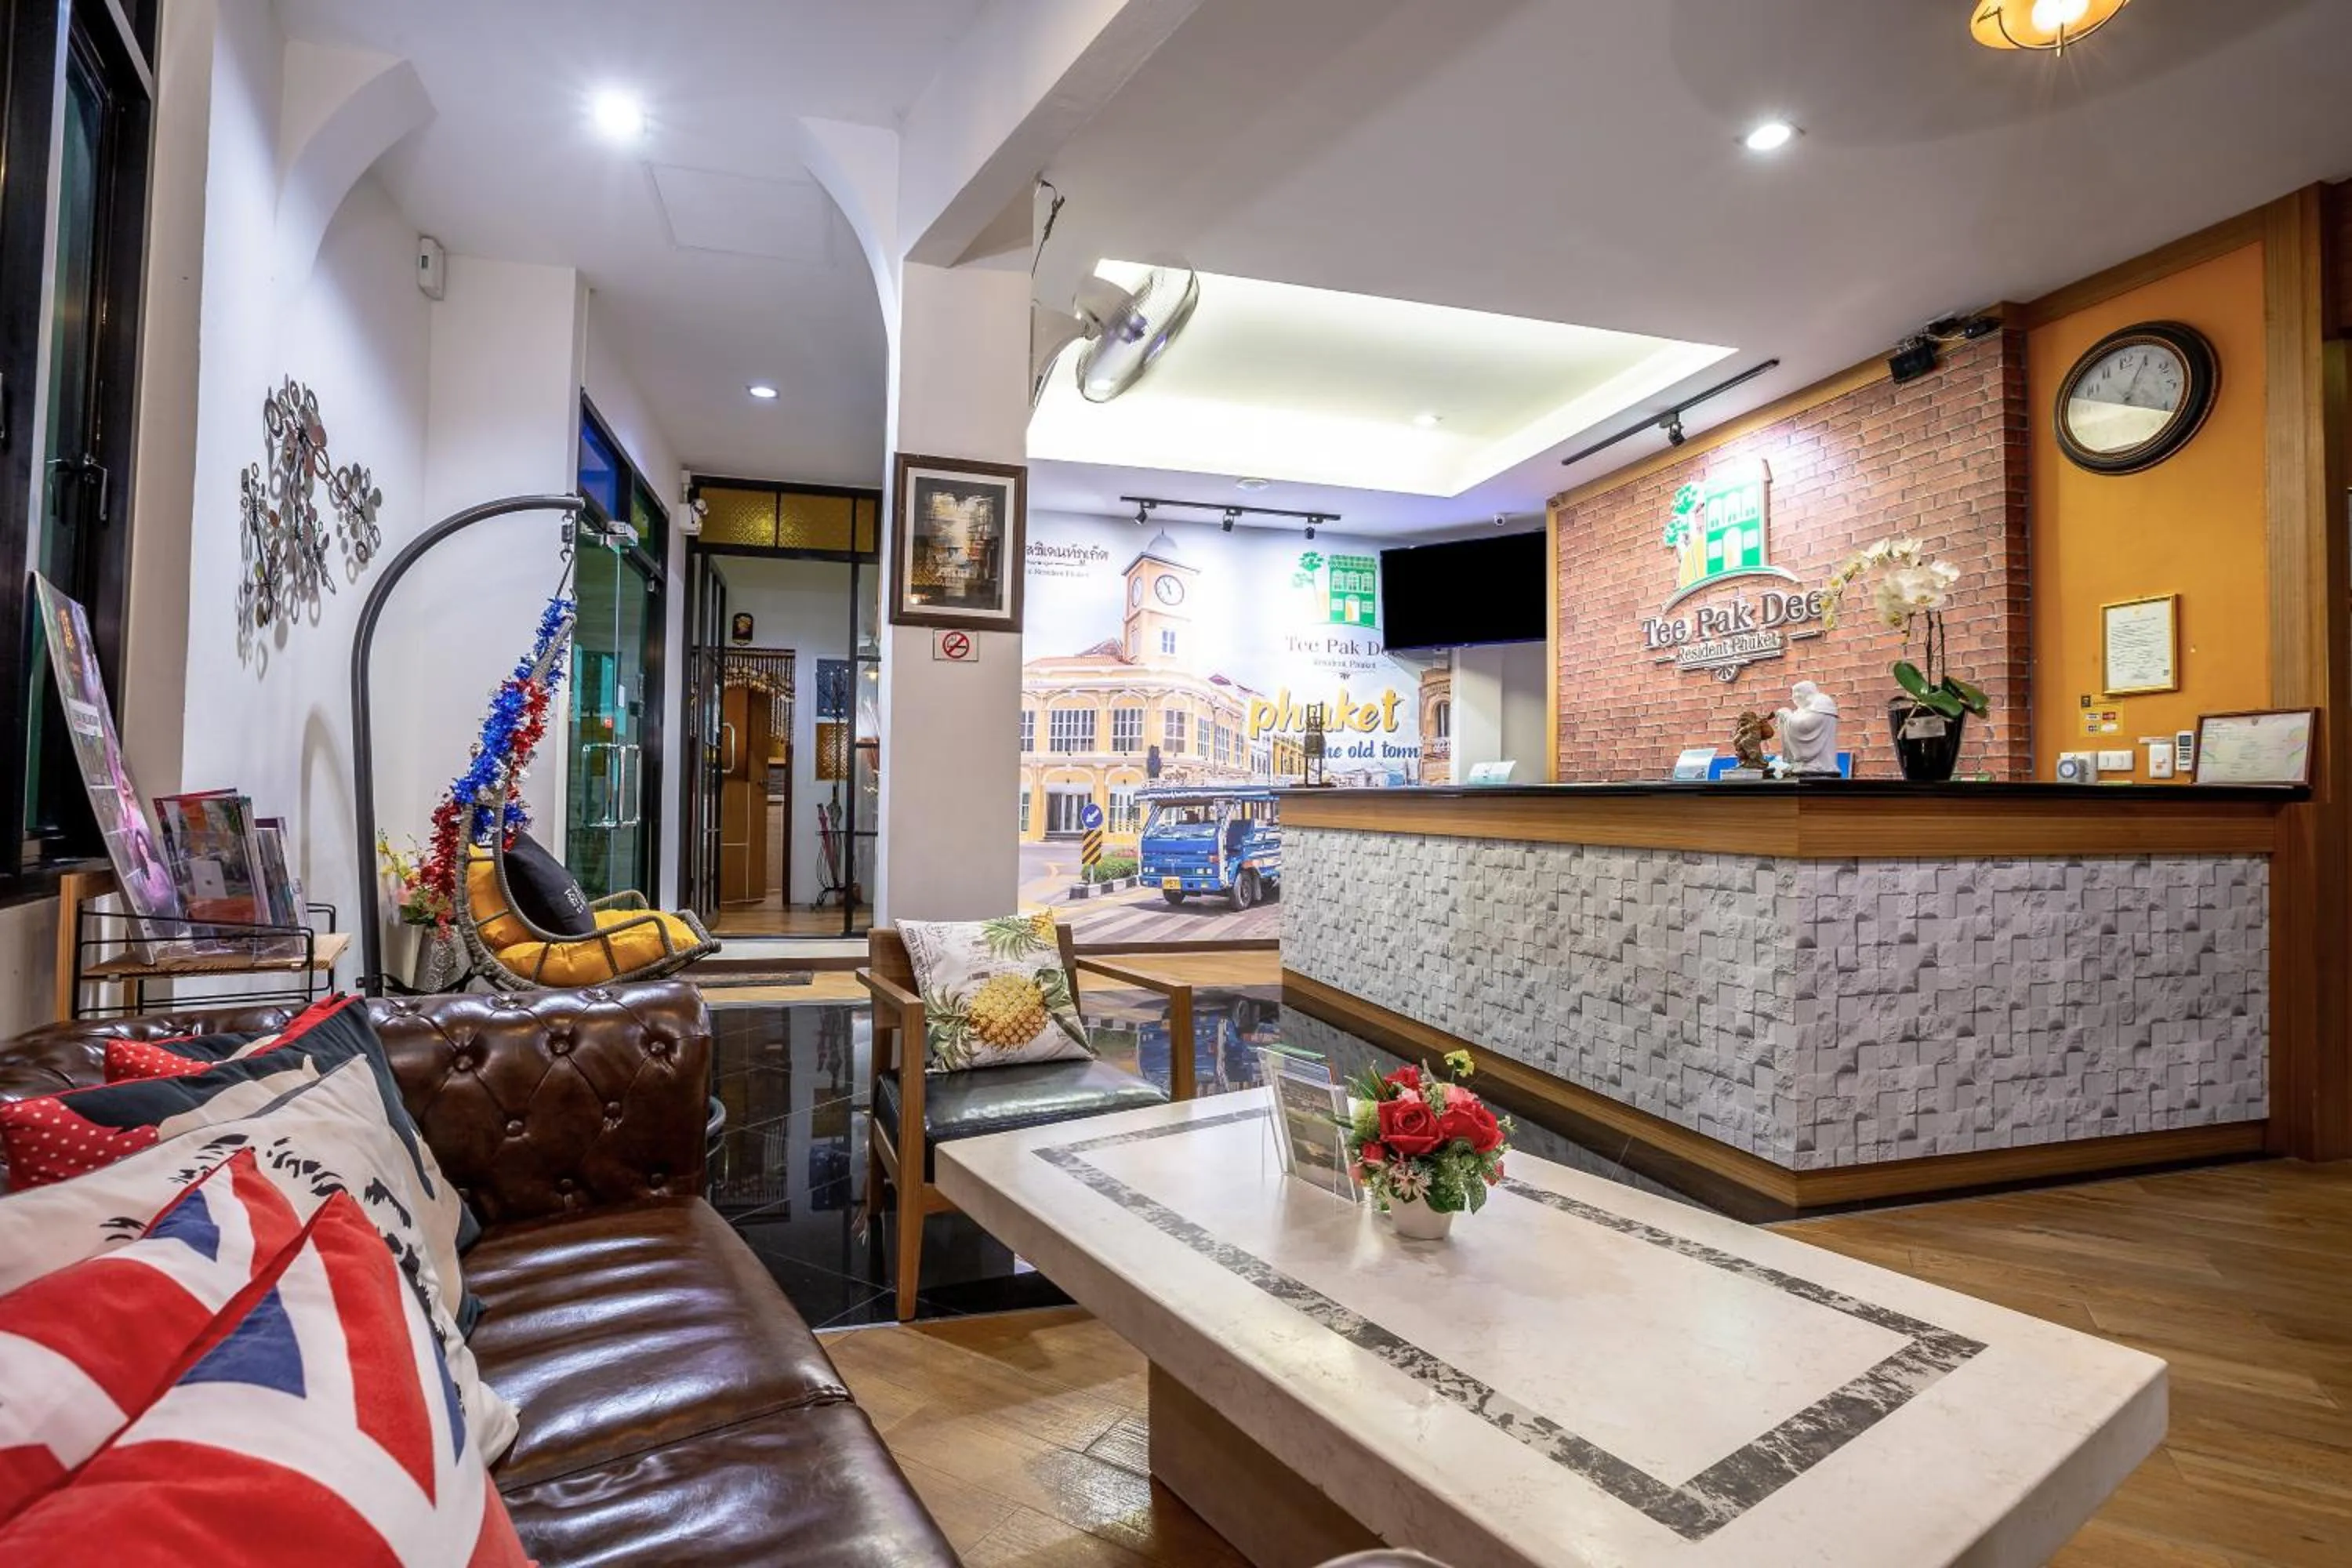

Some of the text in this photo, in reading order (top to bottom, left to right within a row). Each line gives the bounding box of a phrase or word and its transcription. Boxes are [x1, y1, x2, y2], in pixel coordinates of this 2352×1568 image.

[1642, 590, 1823, 649] Tee Pak Dee
[1286, 635, 1319, 652] Tee
[1327, 638, 1360, 655] Pak
[1677, 632, 1779, 663] Resident Phuket
[1348, 739, 1374, 759] old
[1381, 740, 1421, 759] town
